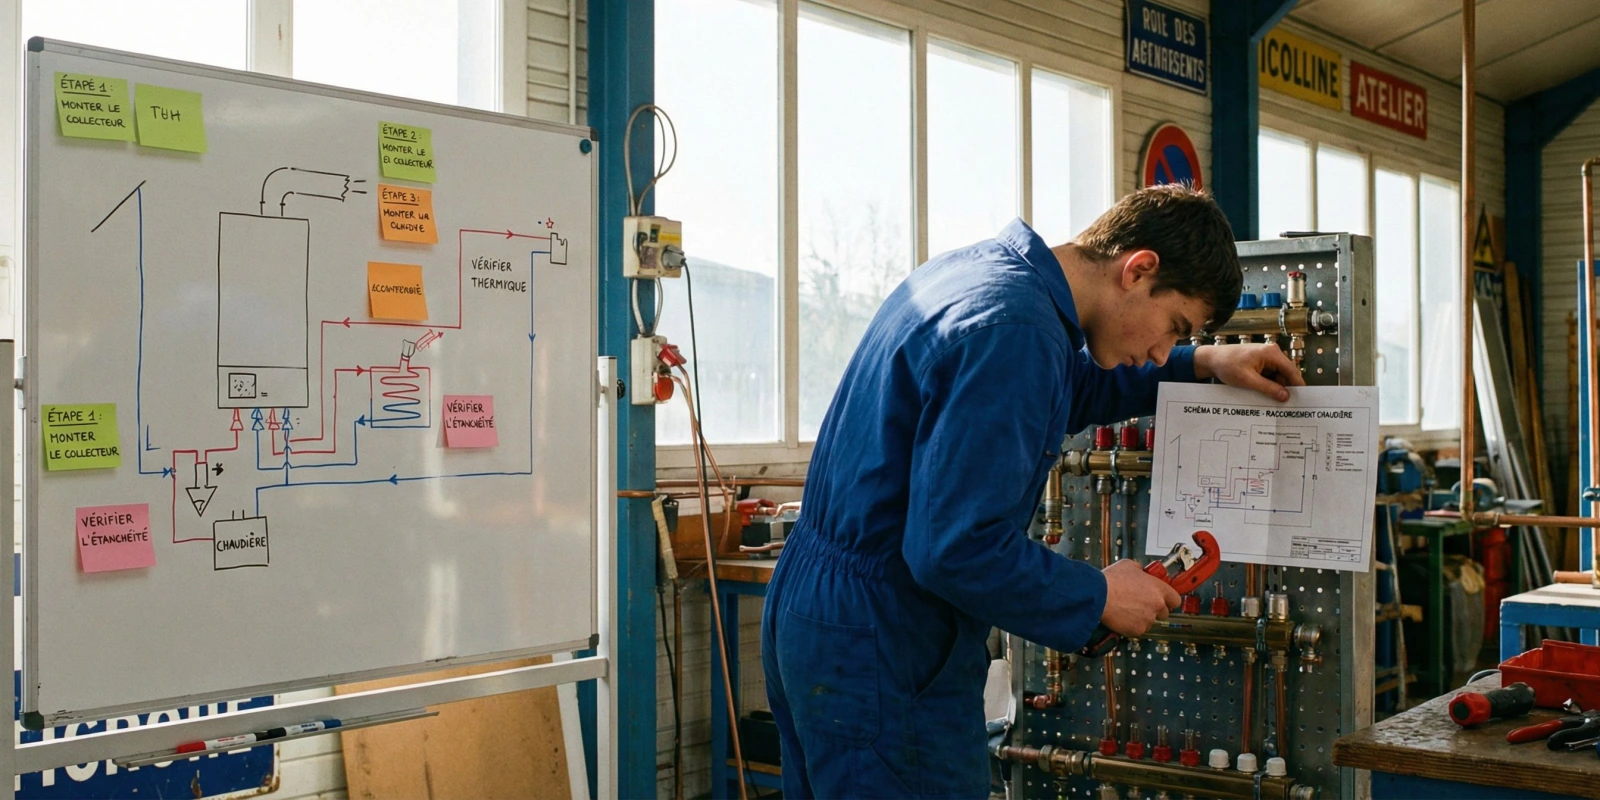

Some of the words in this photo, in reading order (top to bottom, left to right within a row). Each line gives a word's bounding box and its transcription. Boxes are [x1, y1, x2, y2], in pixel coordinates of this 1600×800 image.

[1174, 18, 1196, 47] DES
[61, 100, 103, 112] MONTER
[108, 104, 121, 113] LE
[1356, 73, 1425, 130] ATELIER
[66, 114, 126, 128] COLLECTEUR
[382, 124, 408, 138] ÉTAPE
[382, 143, 413, 155] MONTER
[416, 148, 426, 156] LE
[393, 157, 434, 169] COLLECTEUR
[382, 188, 407, 202] ÉTAPE
[383, 208, 415, 220] MONTER
[471, 256, 512, 272] VÉRIFIER
[446, 399, 484, 413] VÉRIFIER
[1183, 405, 1211, 414] SCHÉMA
[1212, 407, 1221, 415] DE
[48, 407, 83, 422] ÉTAPE
[50, 431, 96, 443] MONTER
[49, 449, 61, 460] LE
[64, 446, 119, 459] COLLECTEUR
[81, 511, 134, 528] VÉRIFIER
[82, 527, 149, 546] L'ÉTANCHÉITÉ
[217, 532, 267, 552] CHAUDIÈRE
